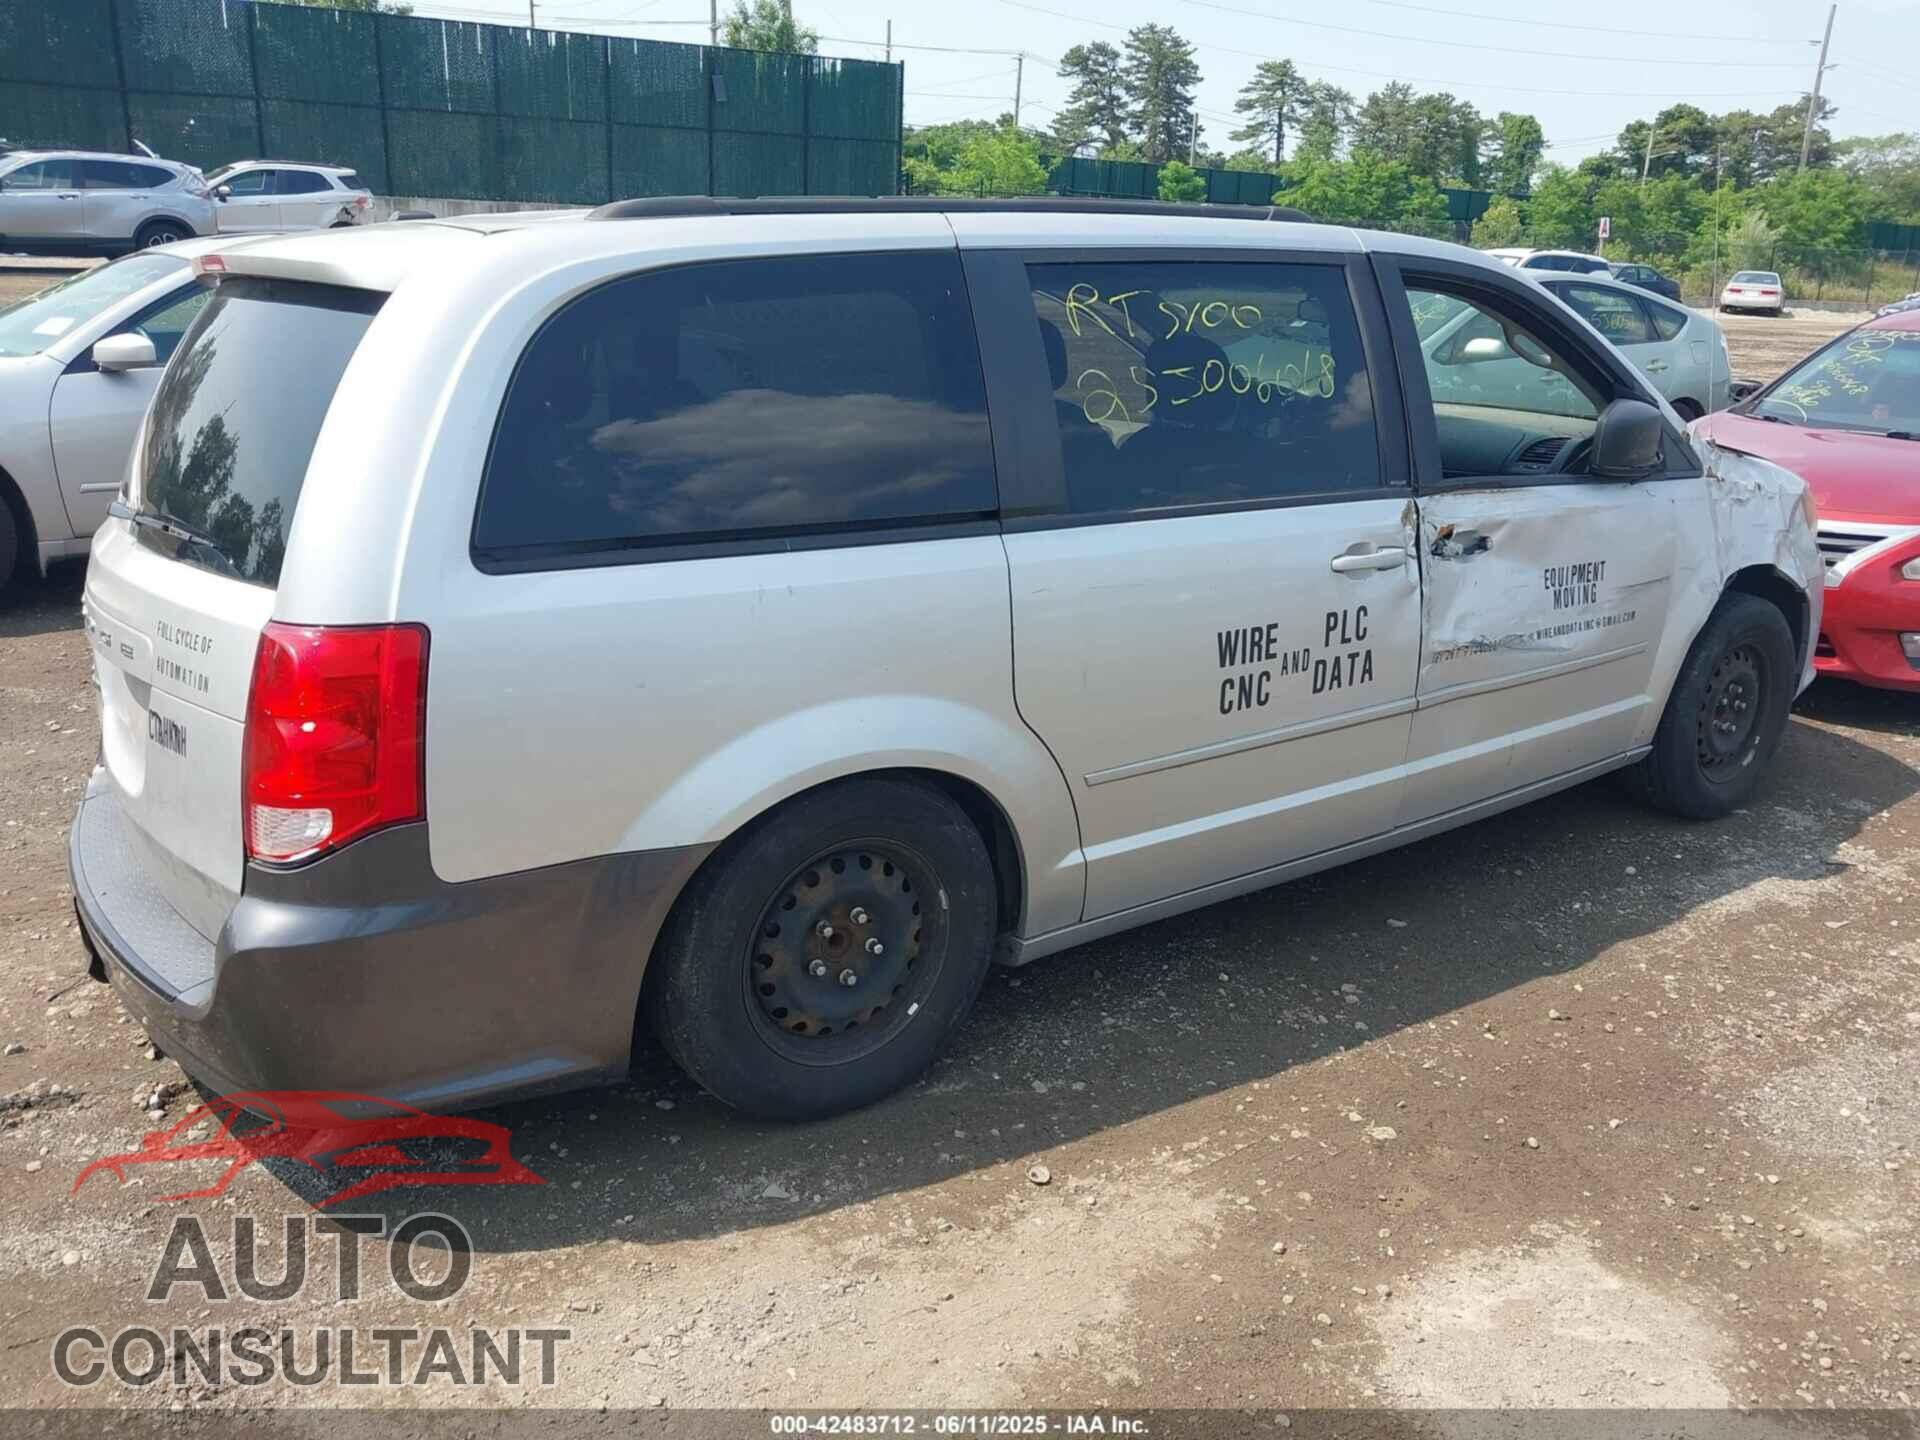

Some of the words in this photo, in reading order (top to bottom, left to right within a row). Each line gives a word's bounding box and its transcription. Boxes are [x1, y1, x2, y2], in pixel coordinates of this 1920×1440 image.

[1065, 283, 1152, 337] RT
[1544, 561, 1606, 590] EQUIPMENT
[1553, 583, 1598, 610] MOVING
[157, 620, 174, 643] FULL
[175, 627, 199, 652] CYCLE
[201, 635, 213, 656] OF
[1217, 622, 1279, 669] WIRE
[1324, 605, 1369, 648] PLC
[156, 656, 210, 694] AUTOMATION
[1281, 648, 1311, 676] AND
[1312, 649, 1374, 694] DATA
[1219, 670, 1271, 715] CNC
